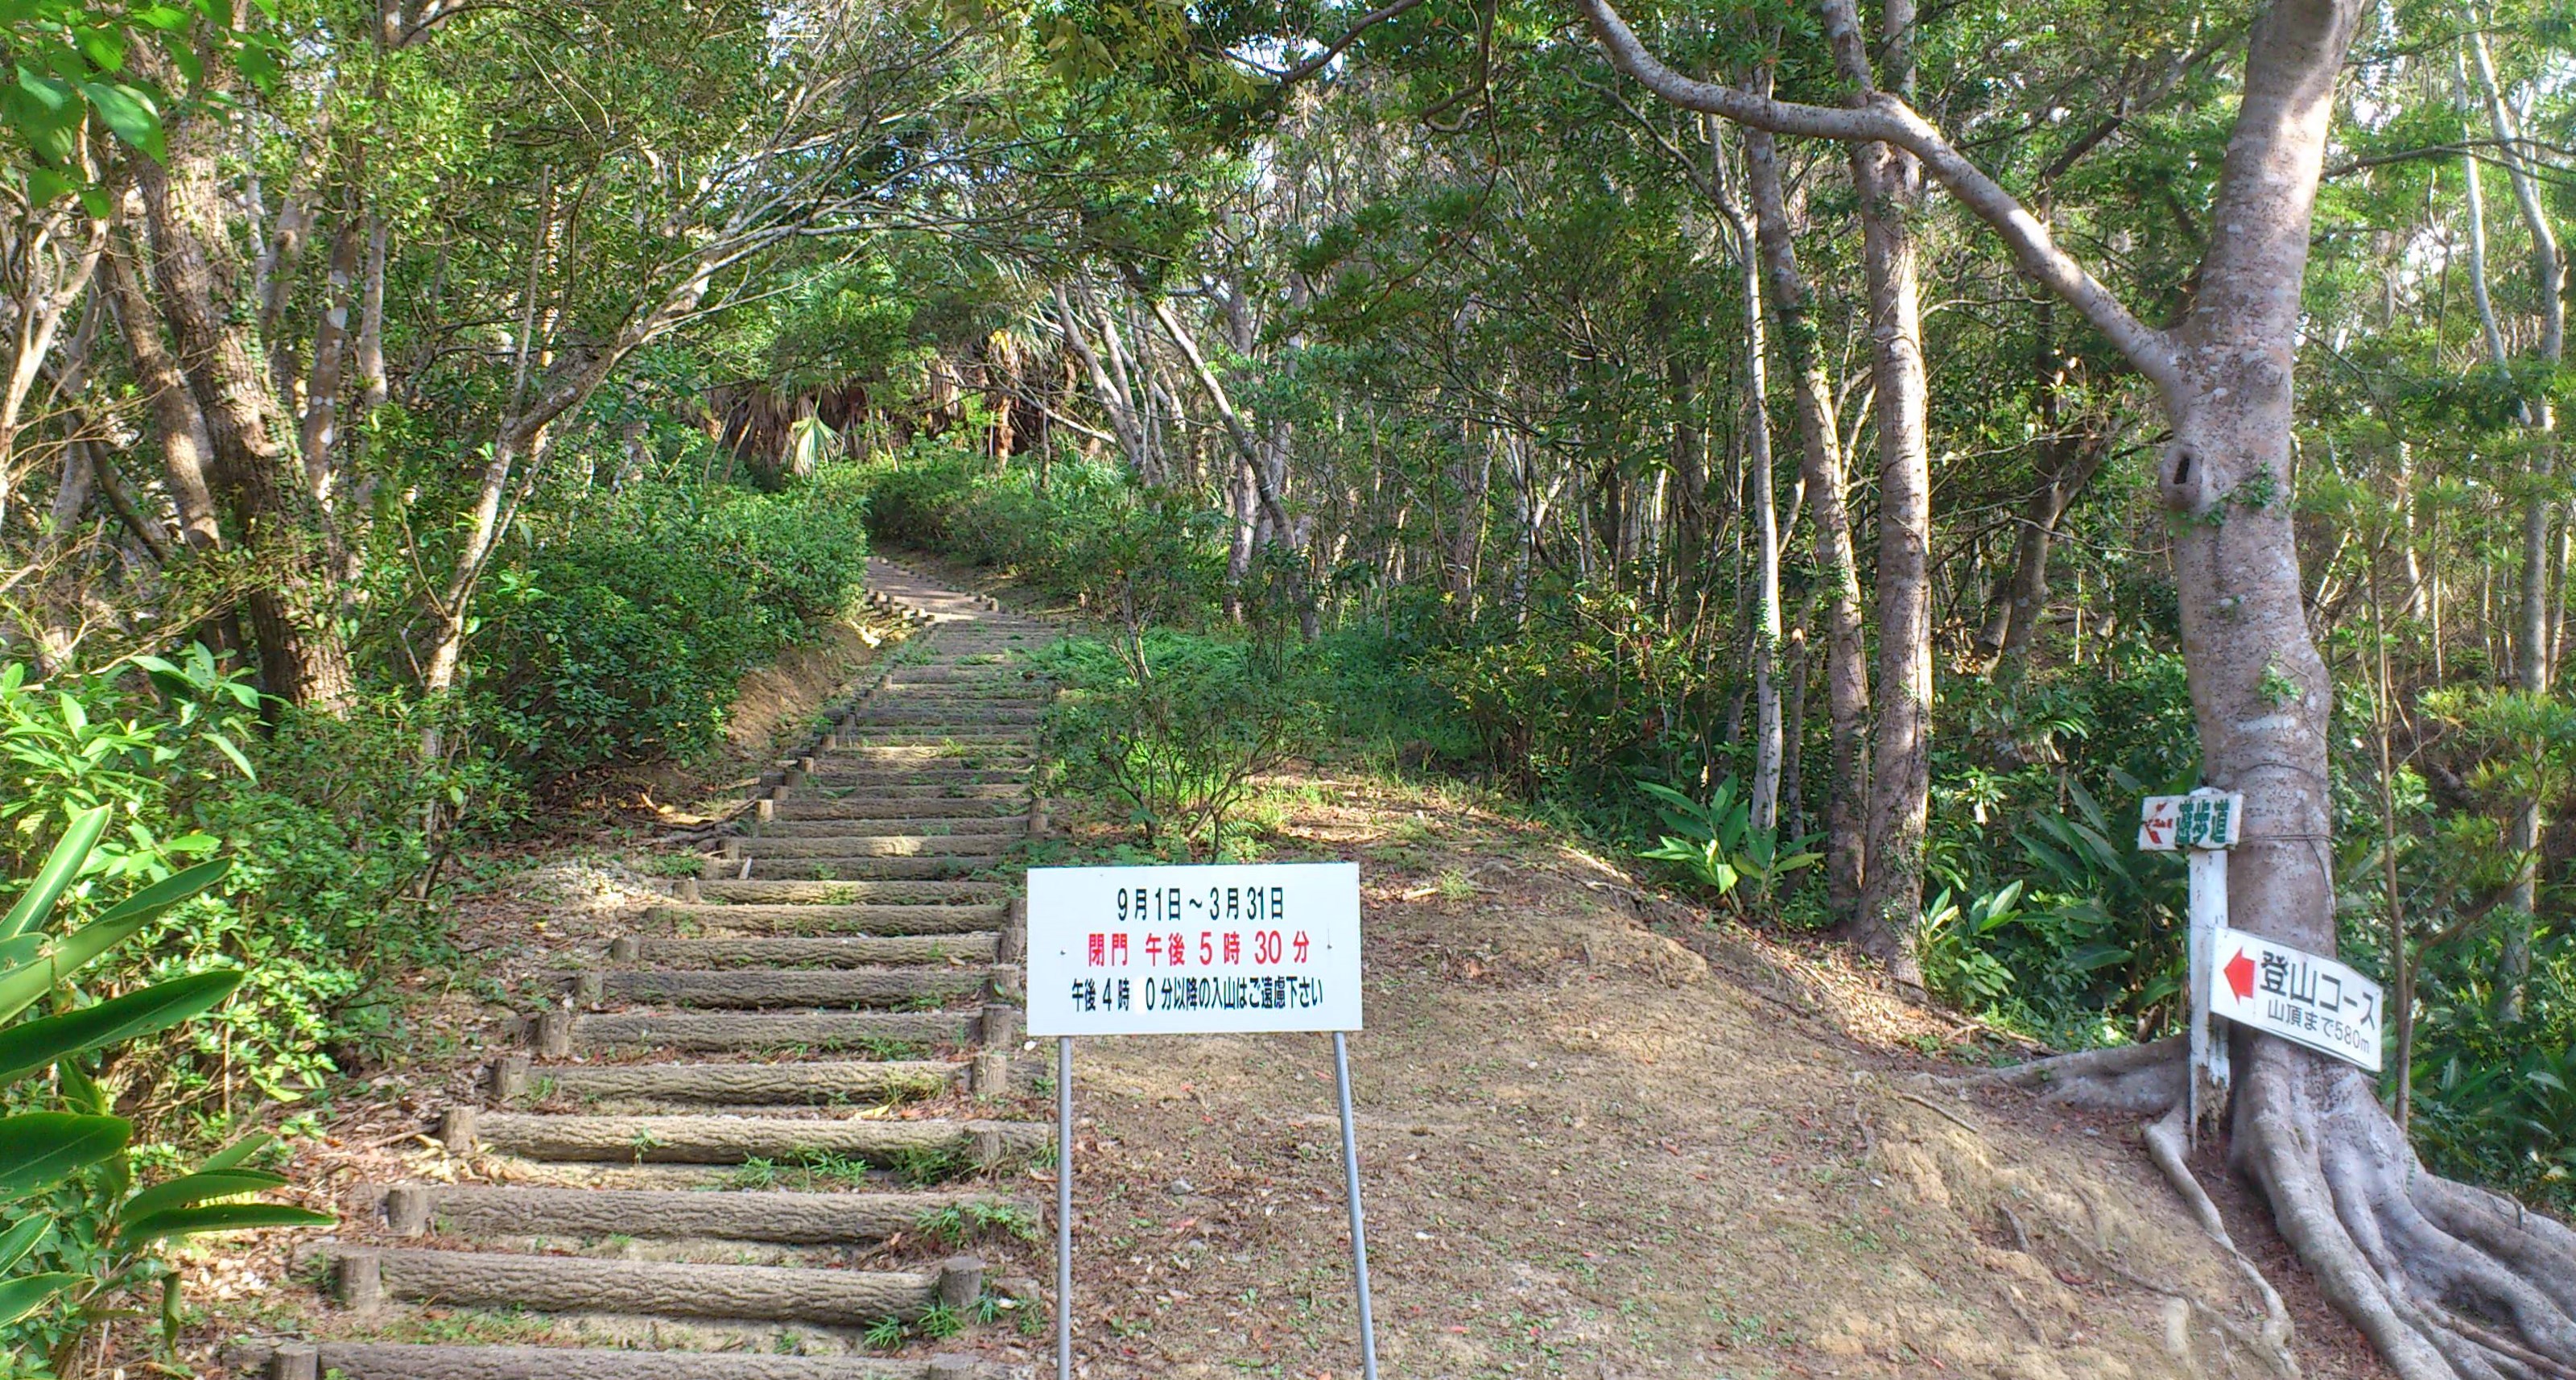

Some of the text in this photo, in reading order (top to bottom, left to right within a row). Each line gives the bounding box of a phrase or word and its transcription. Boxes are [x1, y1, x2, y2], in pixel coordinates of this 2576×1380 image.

[2260, 950, 2376, 1031] 登山コース
[2267, 998, 2370, 1055] 山頂まで580m
